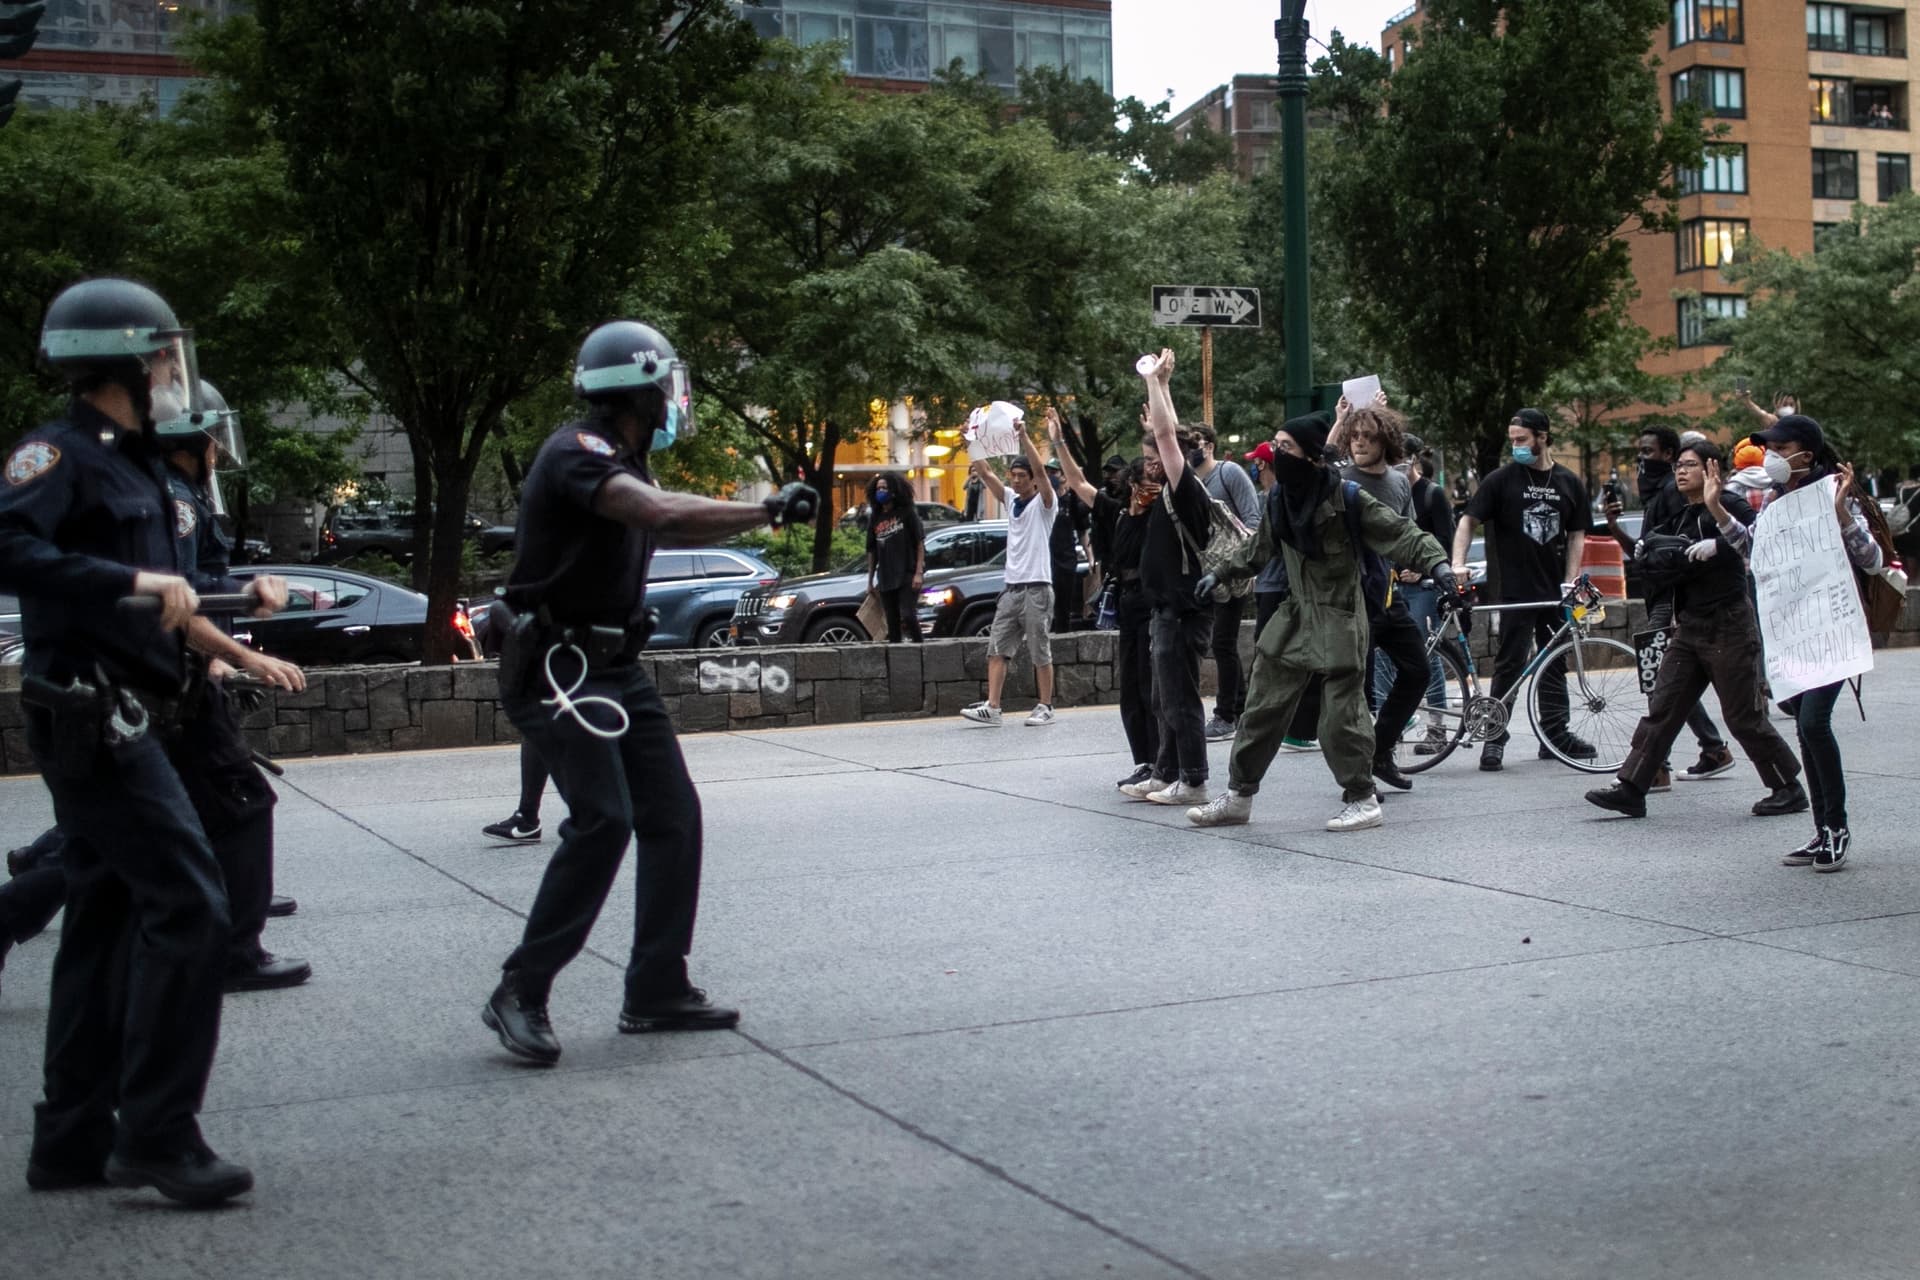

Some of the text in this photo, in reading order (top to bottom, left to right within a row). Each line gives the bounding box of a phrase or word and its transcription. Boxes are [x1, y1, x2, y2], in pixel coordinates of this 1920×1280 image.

[1169, 298, 1244, 315] OE WAY
[1789, 566, 1807, 593] OR
[1768, 589, 1823, 642] EXPECT
[1783, 622, 1857, 679] RESISTANCE
